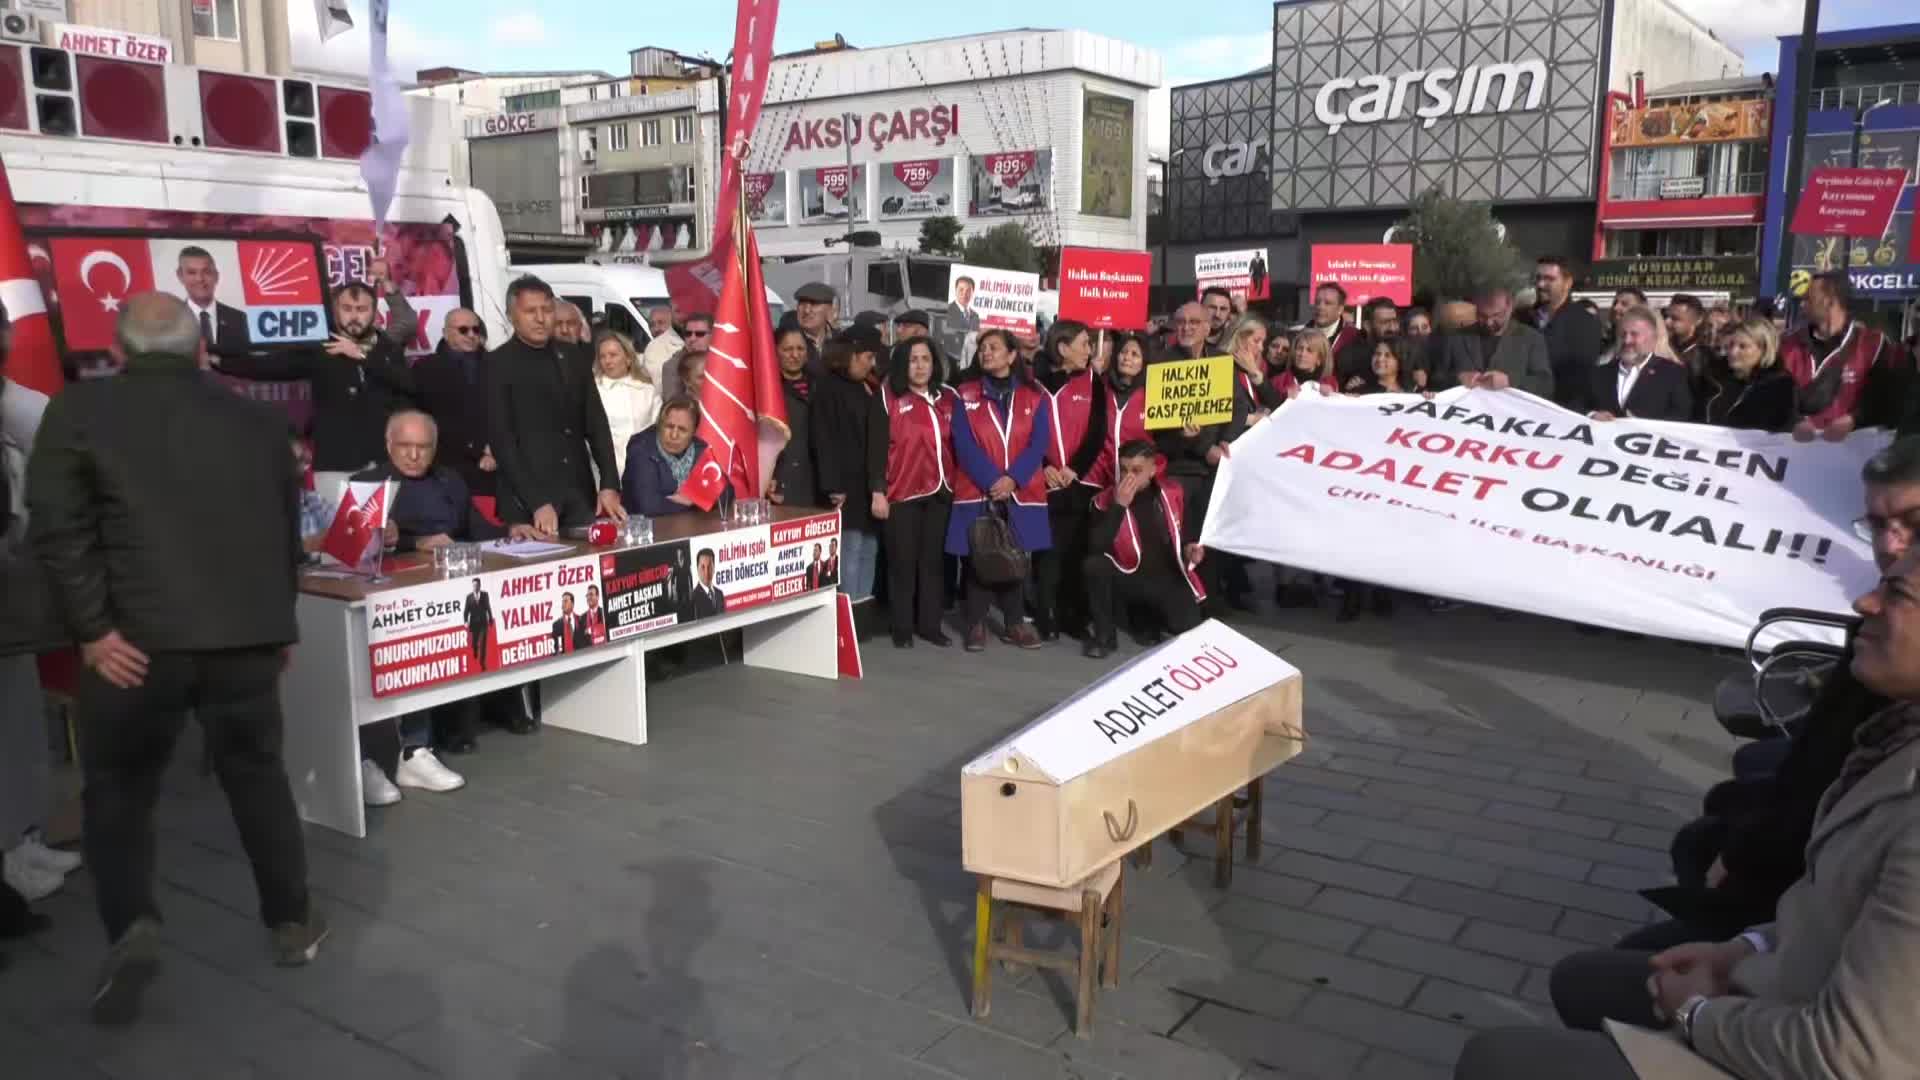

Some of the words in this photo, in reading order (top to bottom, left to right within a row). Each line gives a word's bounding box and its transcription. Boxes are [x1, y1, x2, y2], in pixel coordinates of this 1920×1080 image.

[60, 31, 121, 56] AHMET
[126, 36, 168, 62] ÖZER
[1314, 60, 1547, 135] çarşım
[485, 113, 536, 133] GÖKÇE
[784, 113, 862, 152] AKSU
[869, 104, 958, 151] ÇARŞI
[1202, 139, 1272, 185] çar
[1080, 286, 1102, 298] Halk
[1848, 273, 1920, 289] KCELL
[257, 310, 319, 339] CHP
[1162, 364, 1209, 383] HALKIN
[1276, 444, 1508, 500] ADALET
[1385, 427, 1563, 470] KORKU
[1577, 456, 1740, 505] DEĞİL
[1614, 432, 1789, 483] GELEN
[1327, 485, 1381, 500] CHP
[773, 527, 802, 544] KAYYUM
[804, 518, 837, 538] GİDECEK
[719, 540, 748, 563] BİLİMİN
[749, 537, 766, 559] IŞIĞI
[778, 546, 804, 562] AHMET
[500, 571, 554, 599] AHMET
[557, 564, 594, 587] ÖZER
[716, 567, 734, 585] GERİ
[734, 560, 769, 581] DÖNECEK
[775, 559, 805, 577] BAŞKAN
[608, 592, 633, 613] AHMET
[633, 583, 663, 604] BAŞKAN
[774, 577, 803, 598] GELECEK
[371, 607, 423, 629] AHMET
[425, 600, 461, 618] ÖZER
[375, 601, 400, 613] Prof.
[402, 599, 417, 608] Dr.
[501, 601, 554, 631] YALNIZ
[618, 603, 651, 626] GELECEK
[374, 630, 468, 666] ONURUMUZDUR
[501, 635, 556, 665] DEĞİLDİR
[375, 657, 460, 693] DOKUNMAYIN
[1093, 678, 1184, 744] ADALET
[1163, 643, 1238, 691] ÖLDÜ
